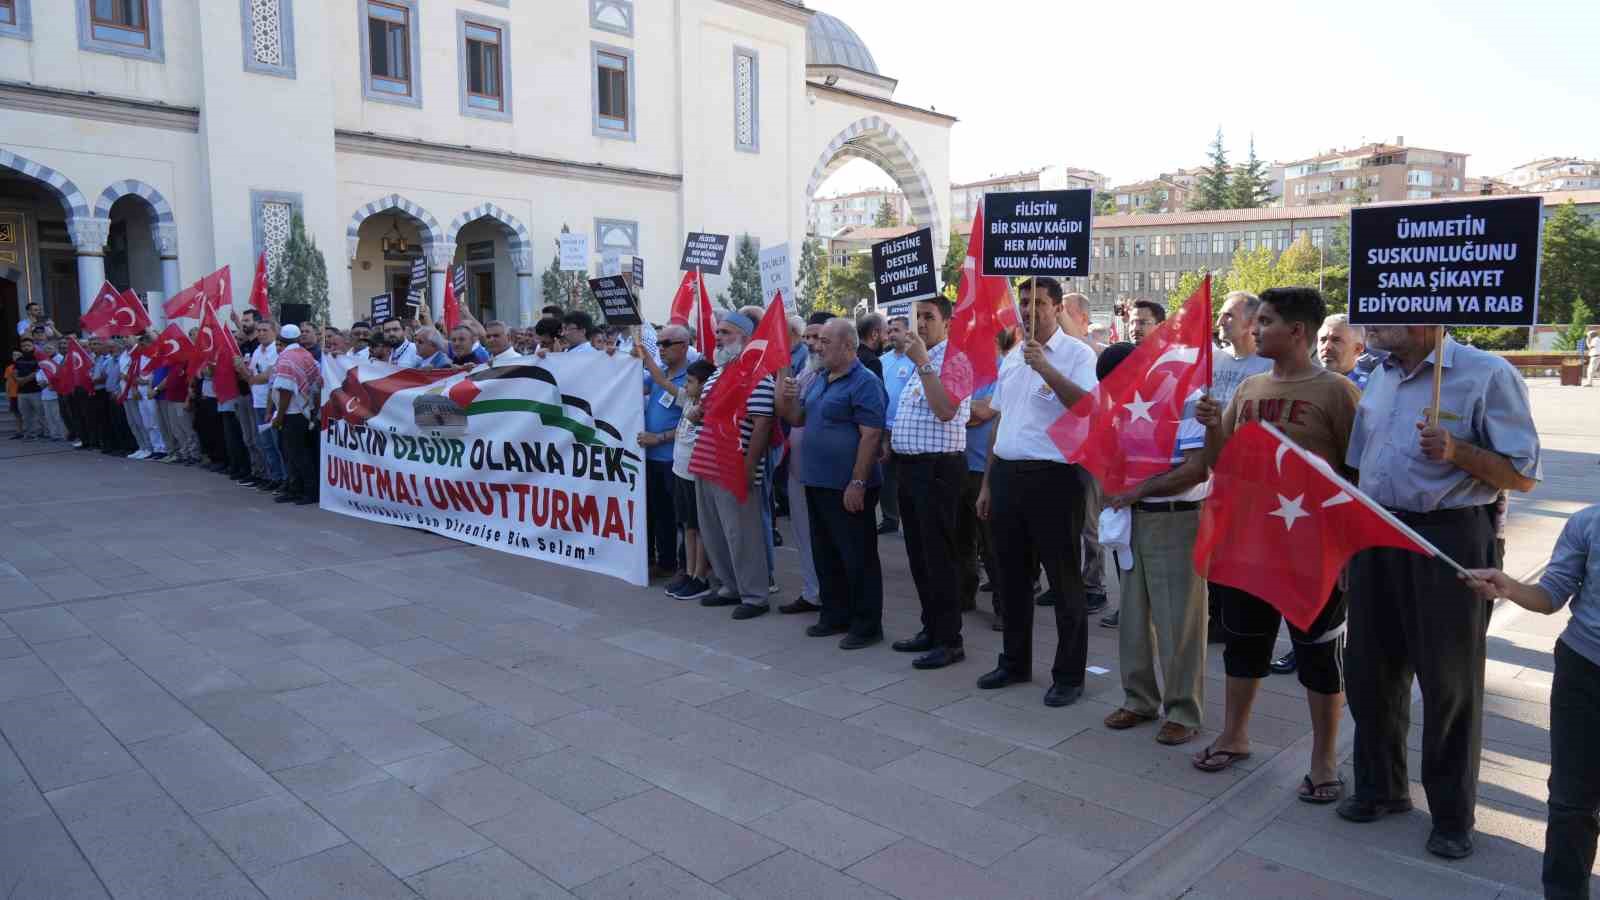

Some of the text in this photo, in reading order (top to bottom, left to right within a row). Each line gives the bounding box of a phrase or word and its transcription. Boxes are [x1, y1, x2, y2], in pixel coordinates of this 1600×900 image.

[1015, 201, 1057, 217] FİLİSTİN
[991, 218, 1083, 235] BİR SINAV KAĞIDI
[1397, 214, 1486, 239] ÜMMETİN
[881, 236, 921, 256] FİLİSTİNE
[1004, 236, 1067, 252] HER MÜMİN
[1367, 241, 1517, 265] SUSKUNLUĞUNU
[886, 252, 919, 269] DESTEK
[994, 254, 1078, 269] KULUN ÖNÜNDE
[880, 263, 929, 285] SİYONİZME
[1378, 267, 1504, 292] SANA ŞİKAYET
[891, 280, 919, 296] LANET
[1358, 293, 1523, 313] EDİYORUM YA RAB
[389, 426, 466, 468] ÖZGÜR
[469, 438, 565, 476] OLANA
[572, 443, 635, 491] DEK,
[327, 454, 635, 544] UNUTMA! UNUTTURMA!
[507, 530, 531, 549] Bin
